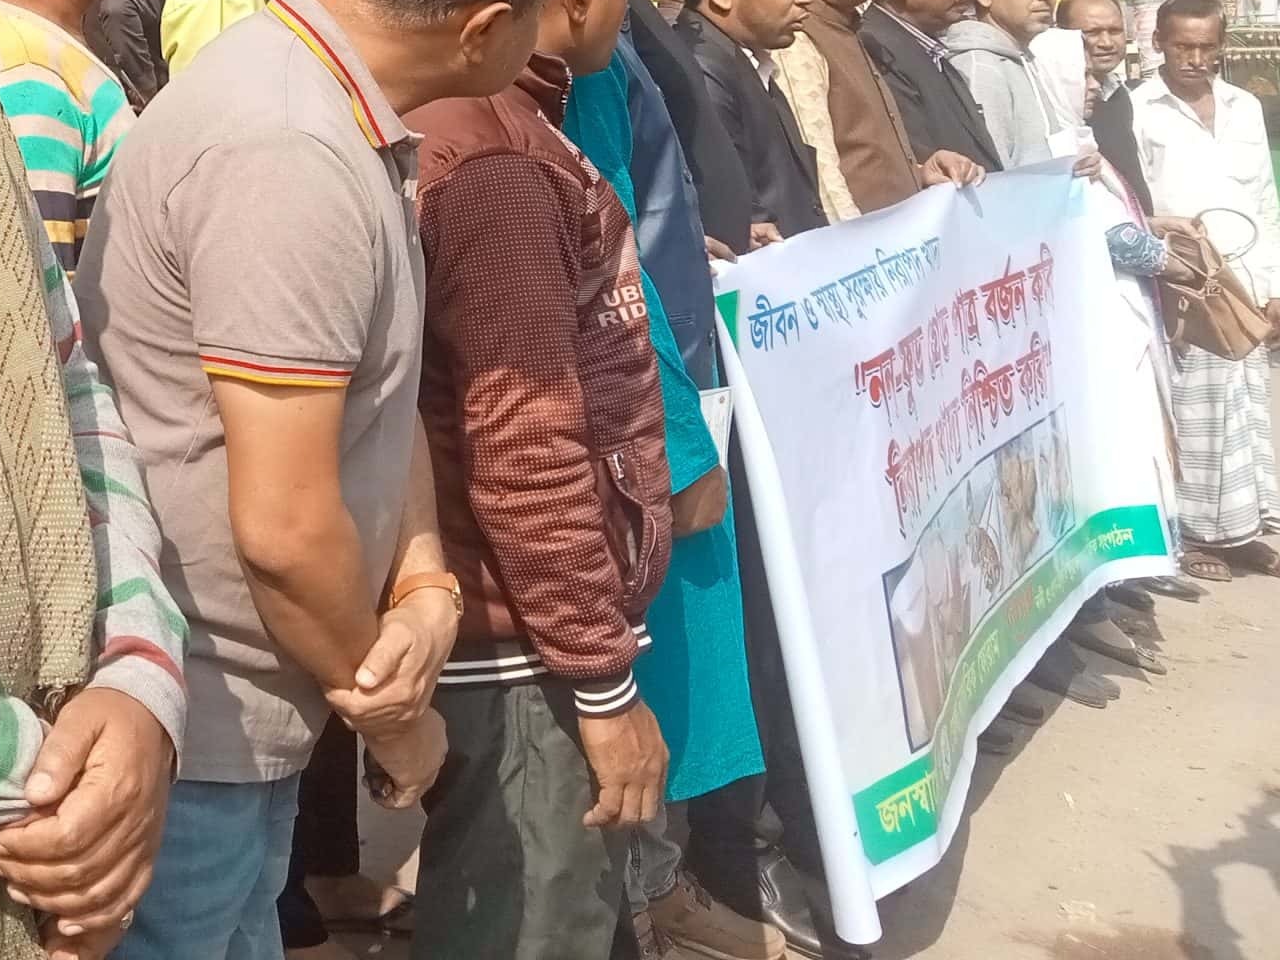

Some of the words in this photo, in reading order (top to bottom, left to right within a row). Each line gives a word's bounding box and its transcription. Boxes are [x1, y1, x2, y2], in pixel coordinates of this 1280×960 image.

[747, 294, 801, 352] জীবন
[801, 297, 818, 331] ও
[979, 253, 1029, 339] বর্জন
